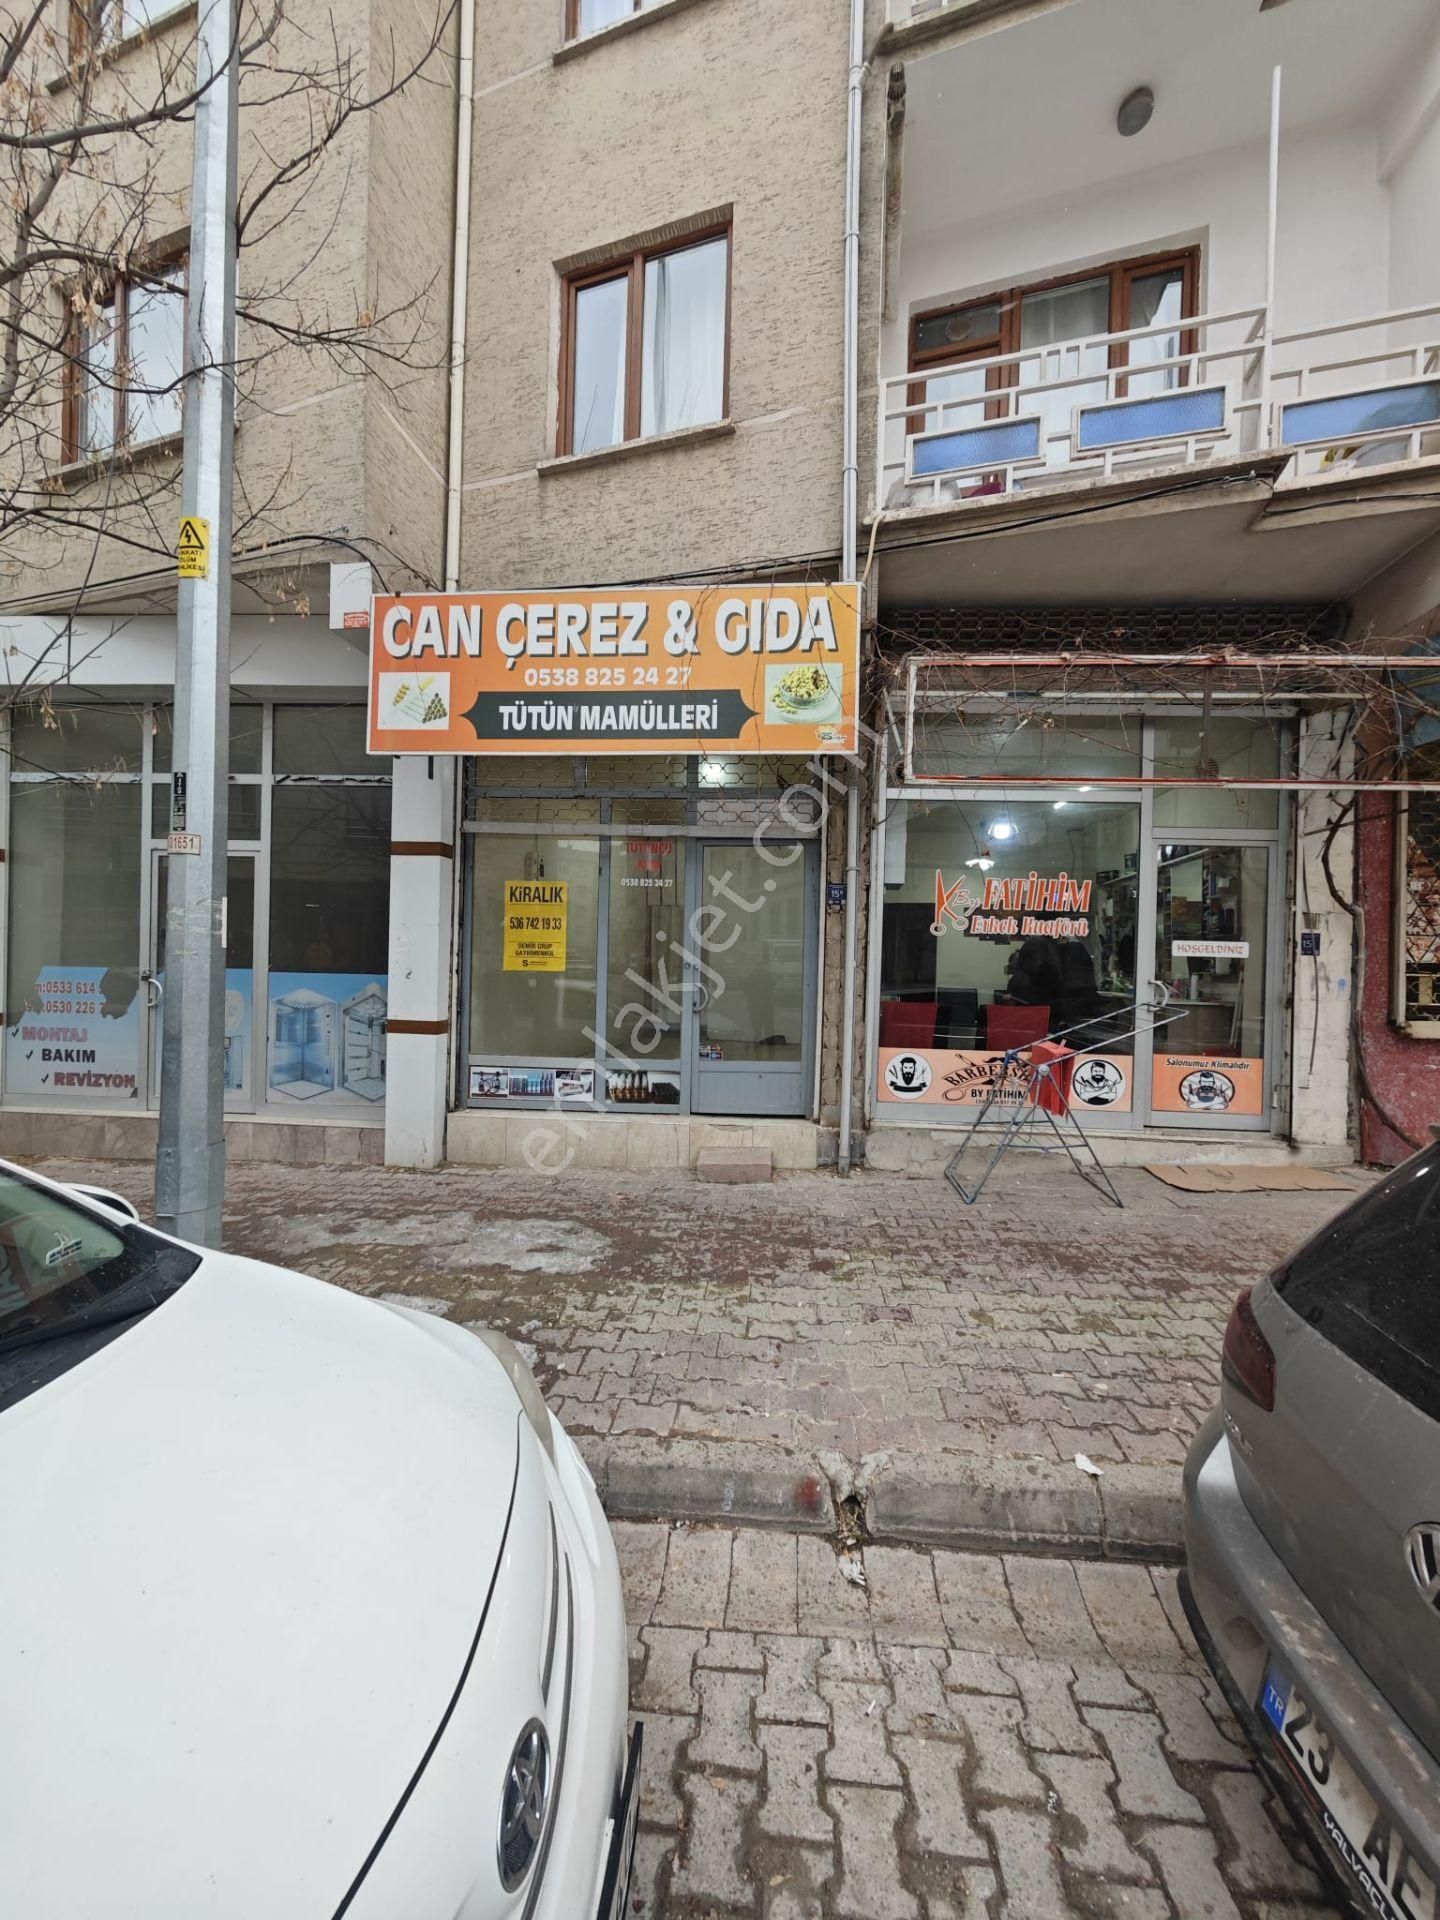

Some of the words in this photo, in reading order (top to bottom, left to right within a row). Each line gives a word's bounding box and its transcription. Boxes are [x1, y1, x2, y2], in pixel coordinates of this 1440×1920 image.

[383, 604, 482, 659] CAN
[496, 602, 649, 671] ÇEREZ
[663, 599, 701, 657] &
[715, 596, 838, 655] GIDA
[524, 667, 580, 687] 0538
[585, 667, 626, 687] 825
[633, 667, 659, 686] 24
[665, 666, 692, 686] 27
[499, 700, 575, 731] TÜTÜN
[580, 699, 718, 731] MAMÜLLERİ
[952, 889, 981, 916] By
[982, 871, 1092, 912] FATİHİM
[509, 916, 524, 930] 536
[525, 916, 540, 930] 742
[542, 917, 551, 930] 19
[552, 917, 562, 930] 33
[970, 915, 1018, 936] Erkek
[1021, 916, 1090, 939] Kuaförü
[76, 982, 95, 994] 614
[76, 1001, 95, 1014] 226
[22, 1026, 88, 1043] MONTAJ
[42, 1048, 96, 1063] BAKIM
[1166, 1057, 1209, 1068] Salonumuz
[1211, 1060, 1250, 1070] Klimalıdır
[54, 1070, 136, 1089] REVİZYON
[971, 1088, 984, 1098] BY
[1268, 1685, 1284, 1716] TR
